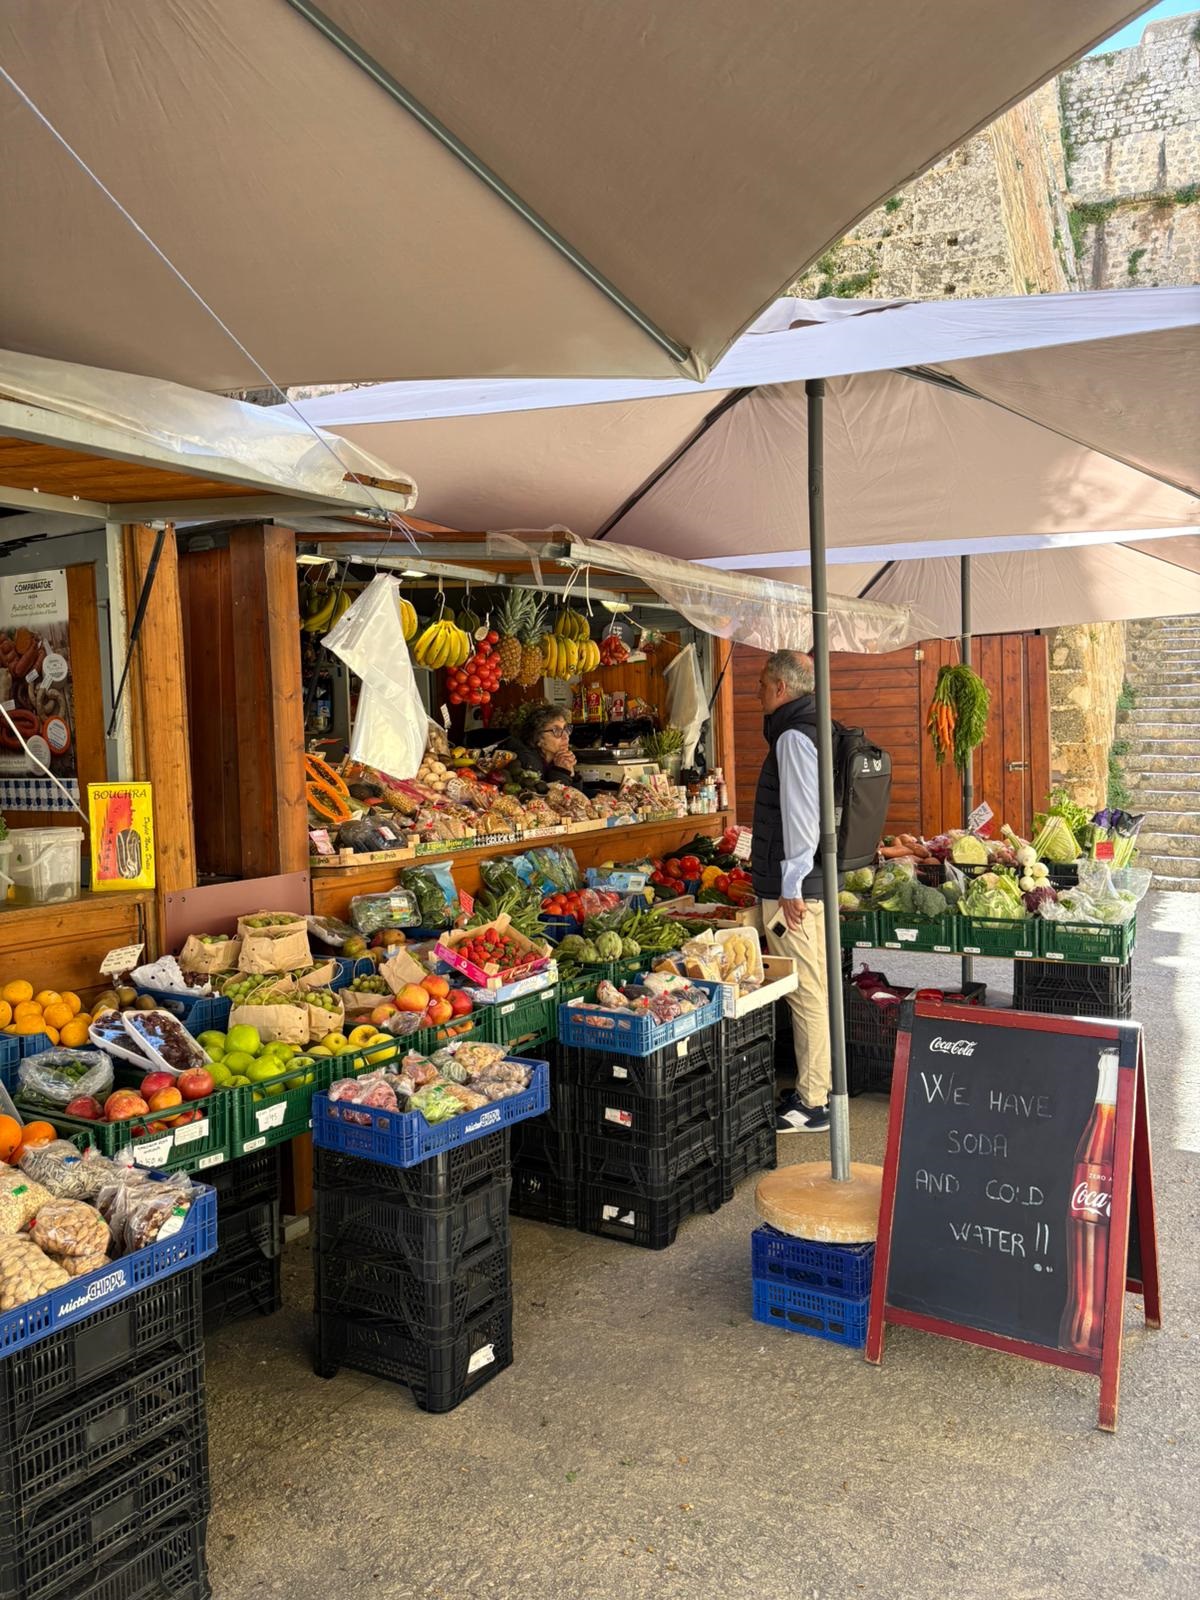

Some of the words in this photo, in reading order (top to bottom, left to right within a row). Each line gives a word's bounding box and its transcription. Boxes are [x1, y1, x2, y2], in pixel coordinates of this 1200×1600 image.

[93, 789, 147, 800] BOUCHRA
[930, 1037, 977, 1056] Coca-Cola
[990, 1090, 1052, 1118] HAVE
[948, 1130, 1007, 1157] SODA
[916, 1169, 960, 1193] AND
[950, 1222, 1025, 1257] WATER
[58, 1294, 89, 1317] Mister
[87, 1270, 126, 1300] CHIPPY
